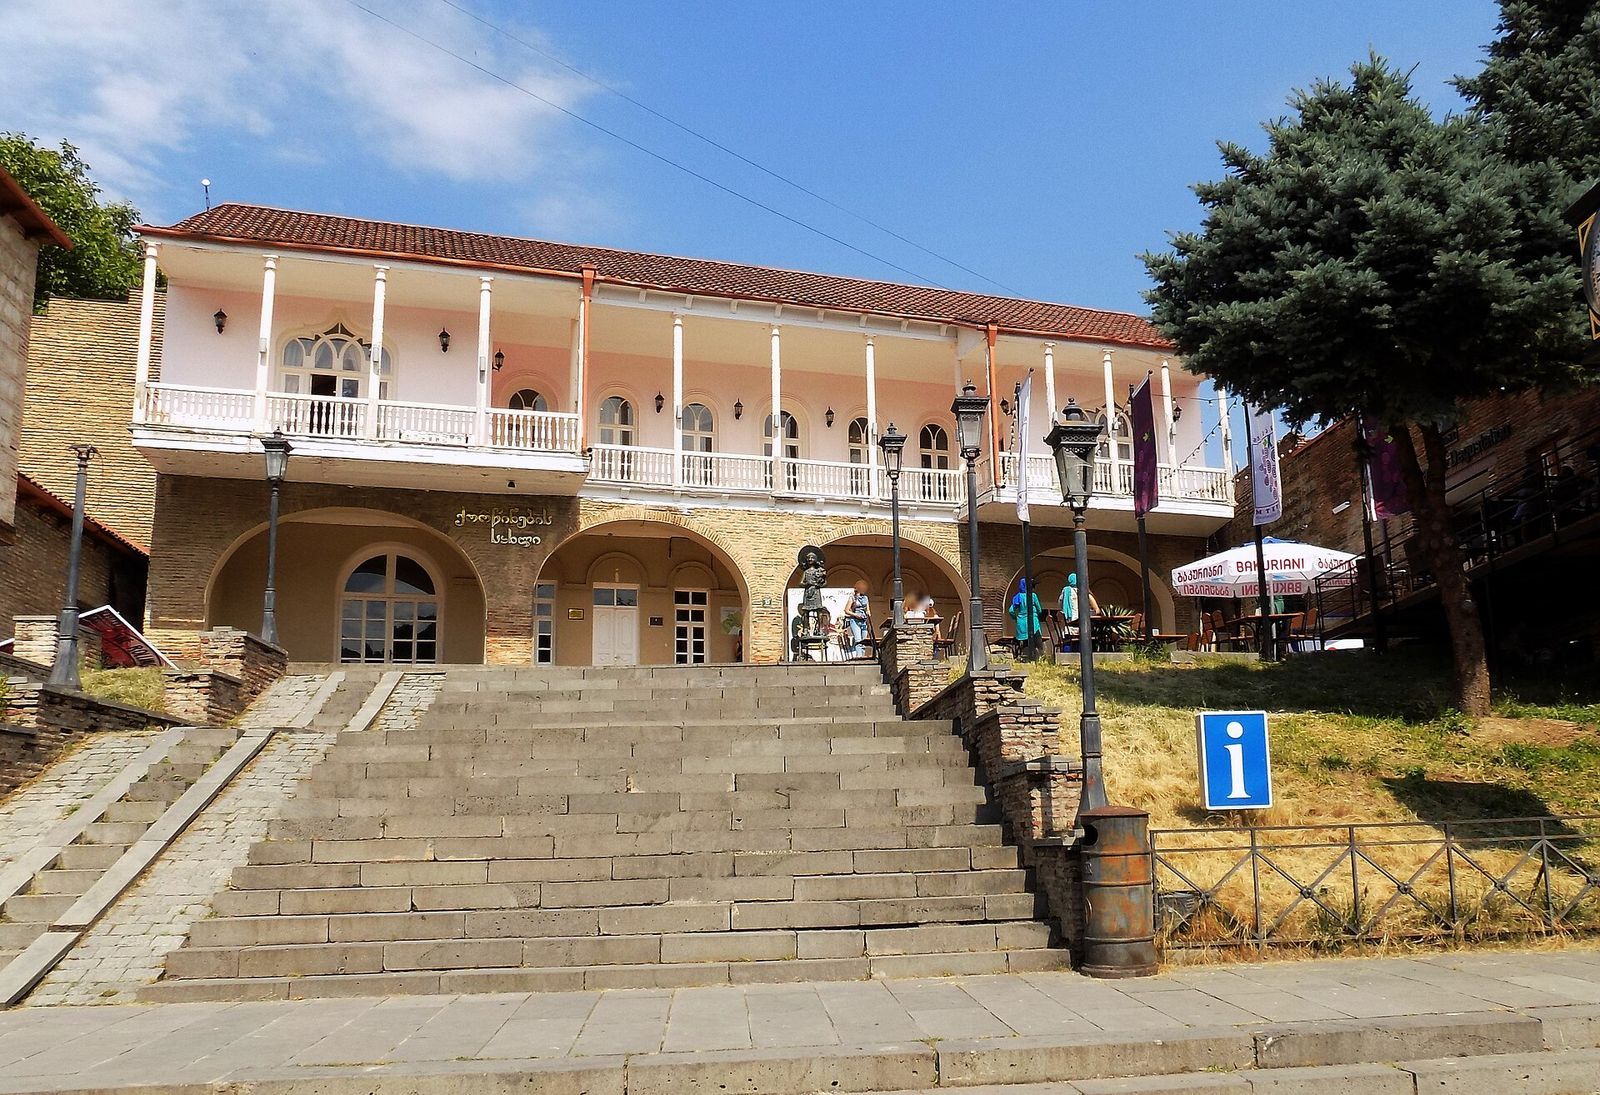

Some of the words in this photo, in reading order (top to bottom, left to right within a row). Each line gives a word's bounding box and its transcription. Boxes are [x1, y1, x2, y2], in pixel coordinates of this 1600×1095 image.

[454, 506, 554, 529] ქორწინების
[490, 528, 541, 548] სახლი
[1177, 565, 1223, 583] ბაკურიანი
